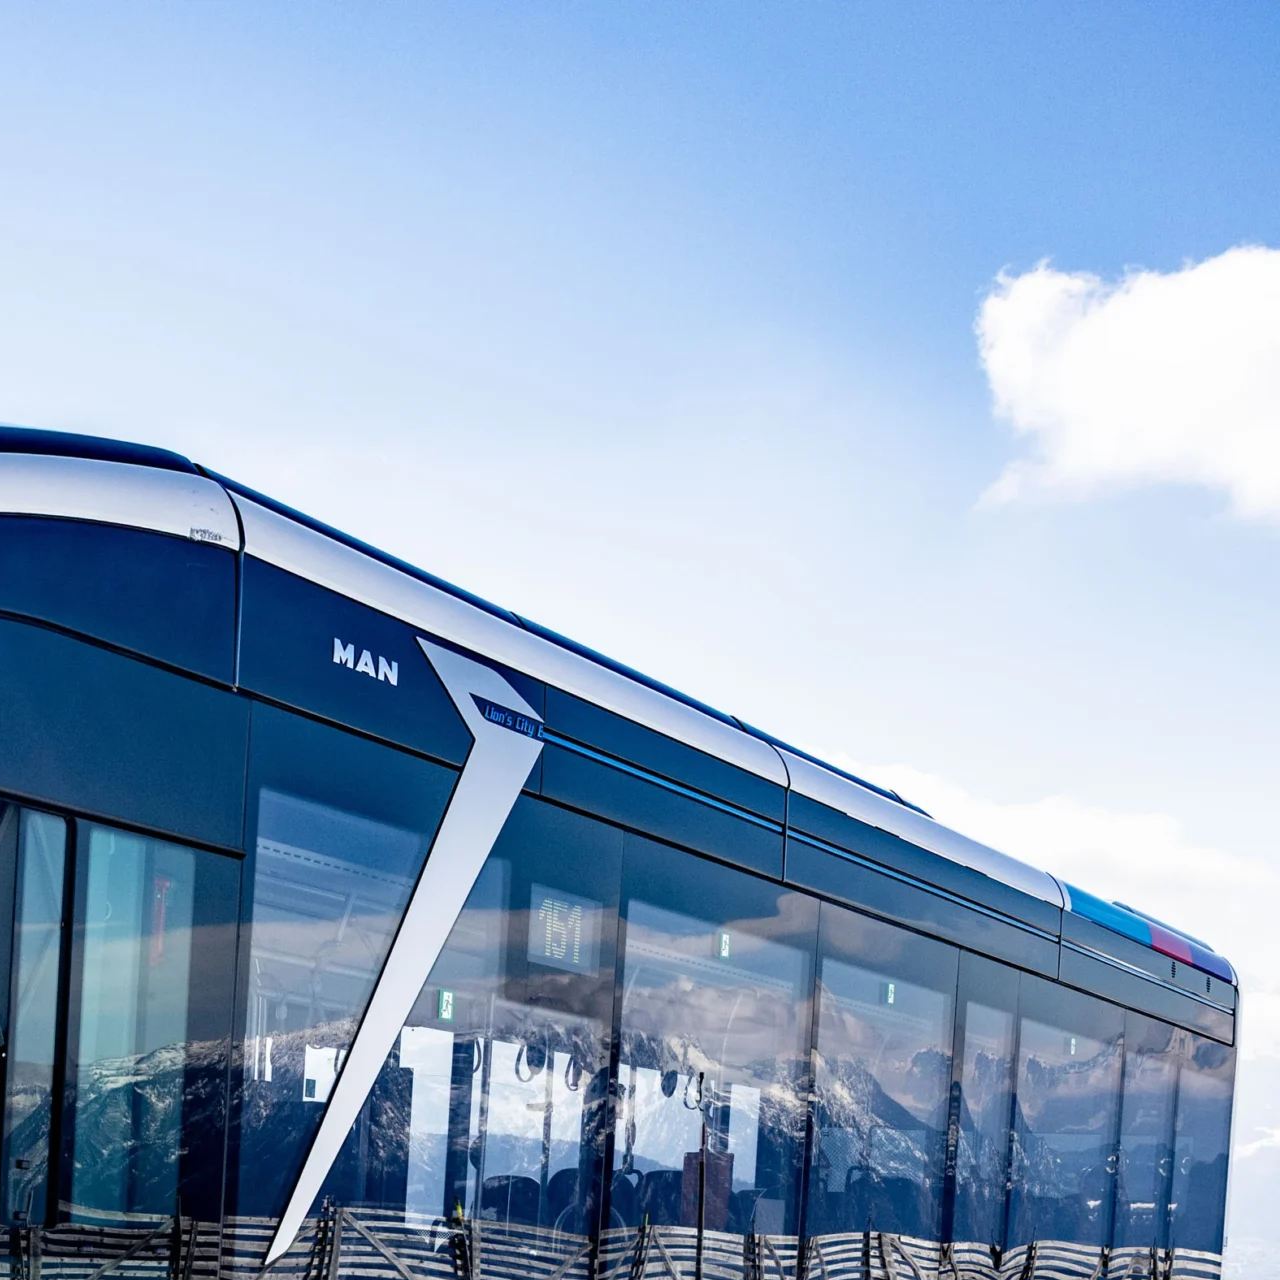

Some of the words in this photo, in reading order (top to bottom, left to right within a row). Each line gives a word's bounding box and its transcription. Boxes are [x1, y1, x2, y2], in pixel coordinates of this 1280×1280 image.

[332, 637, 399, 687] MAN
[484, 704, 513, 726] Lion's
[515, 716, 535, 738] City
[538, 897, 582, 964] 151
